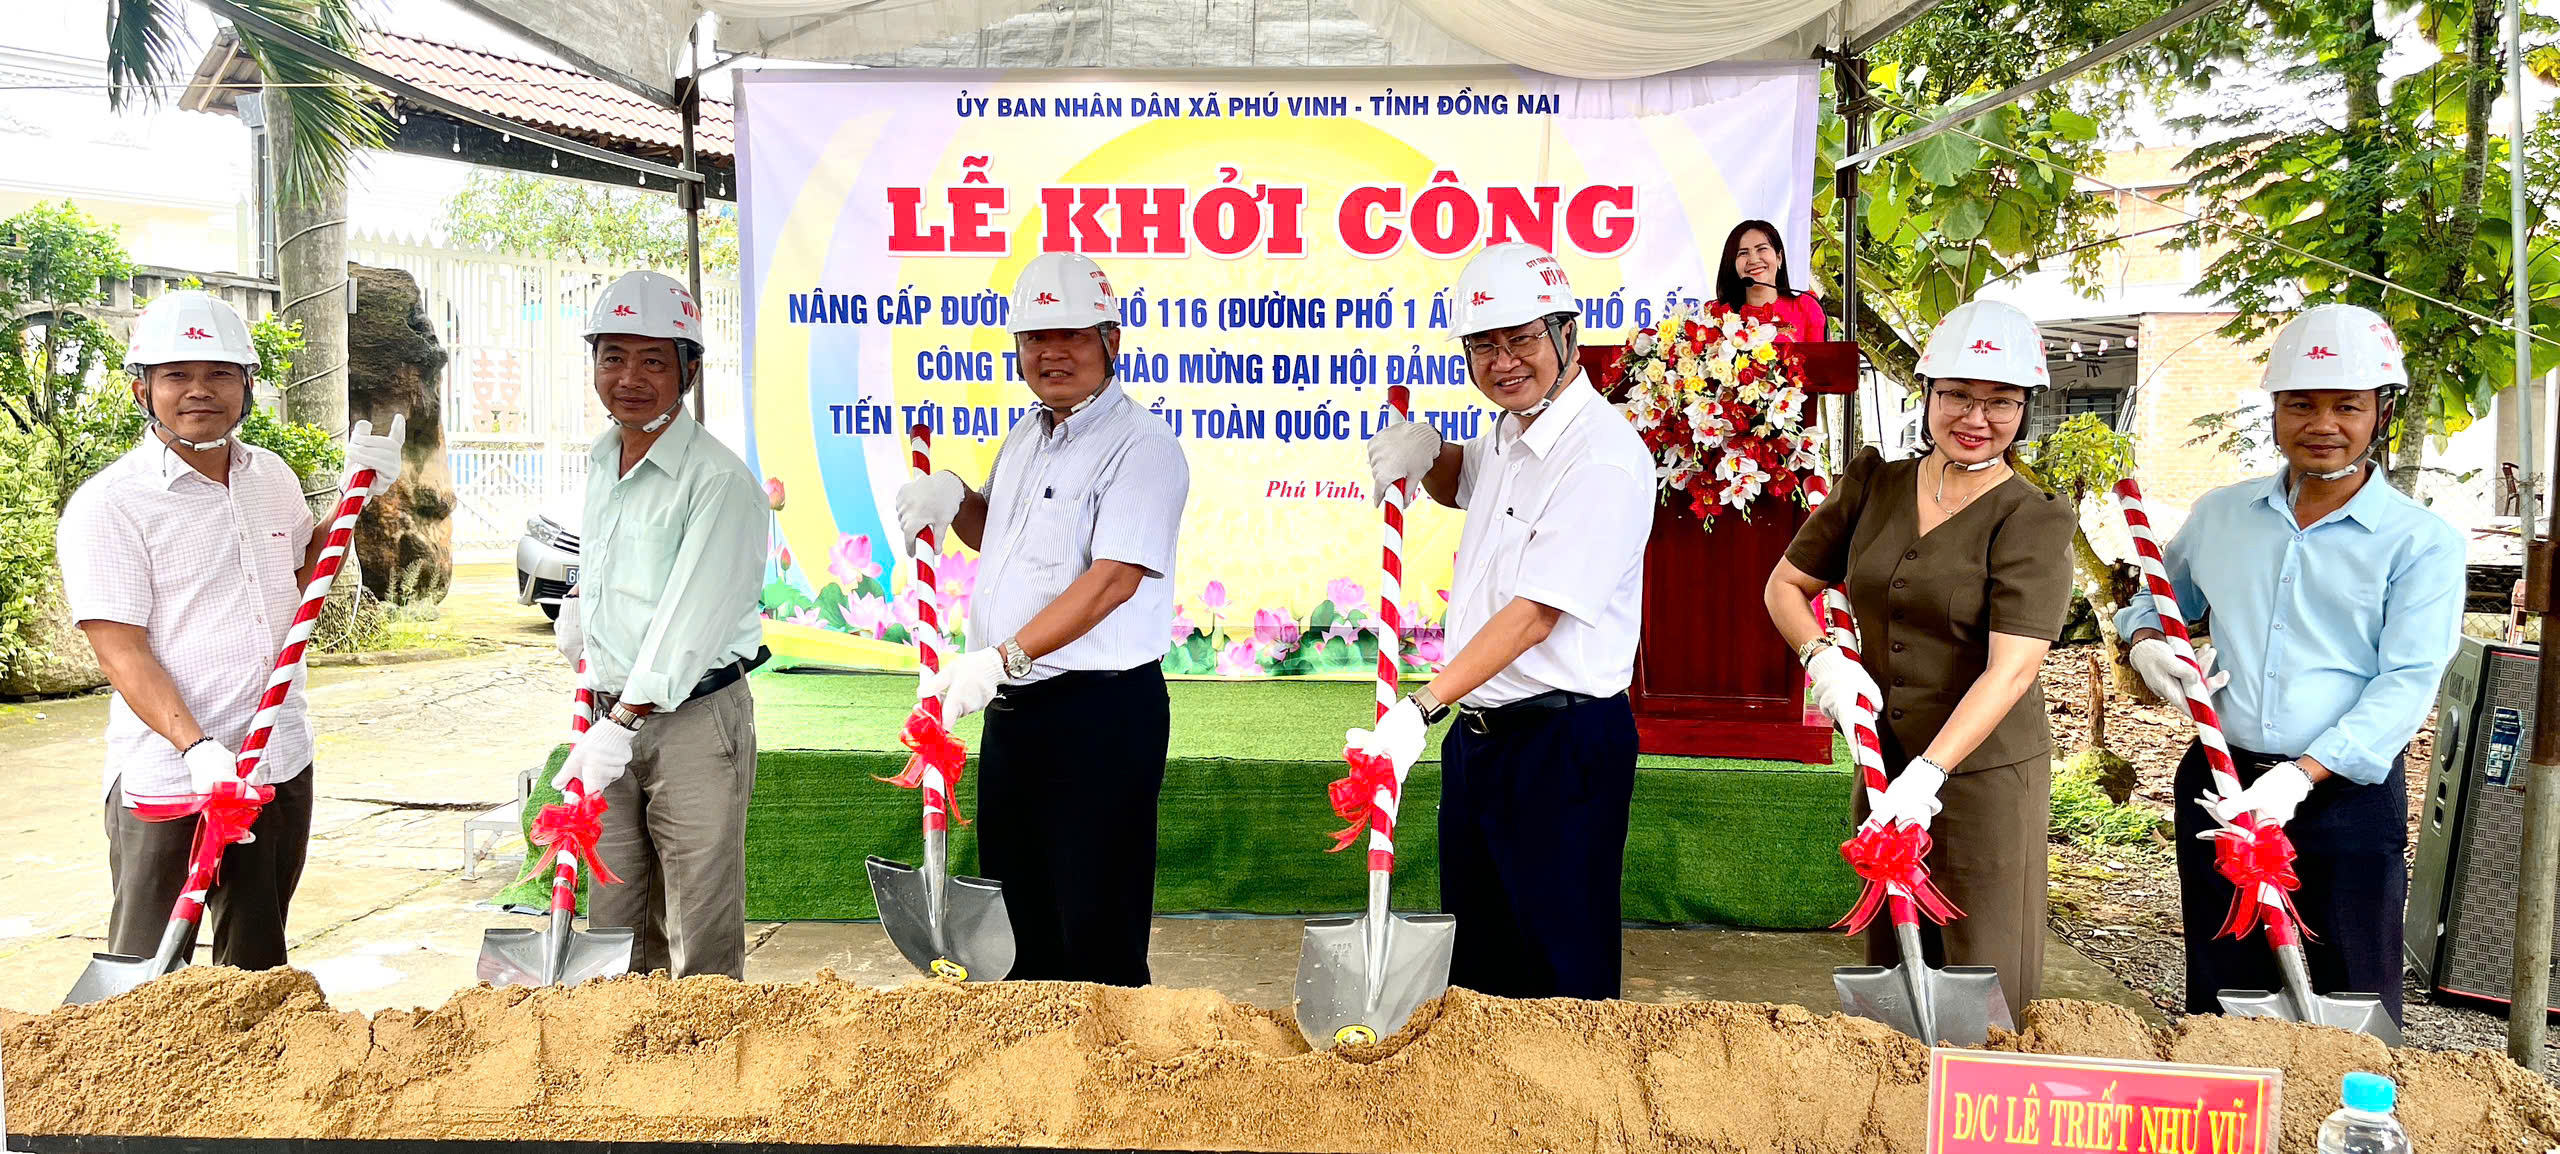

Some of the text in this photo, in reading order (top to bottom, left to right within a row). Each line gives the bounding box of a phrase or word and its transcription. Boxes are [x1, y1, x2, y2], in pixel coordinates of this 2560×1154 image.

[956, 90, 989, 117] ỦY
[997, 97, 1046, 117] BAN
[1054, 92, 1122, 117] NHÂN
[1131, 92, 1180, 117] DÂN
[1188, 91, 1221, 117] XÃ
[1229, 91, 1278, 117] PHÚ
[1287, 96, 1347, 116] VINH
[1370, 88, 1429, 116] TỈNH
[1437, 87, 1508, 116] ĐỒNG
[1517, 94, 1560, 115] NAI
[887, 155, 1635, 255] LỄ KHỞI CÔNG
[789, 288, 868, 324] NÂNG
[877, 285, 931, 325] CẤP
[941, 289, 1010, 326] ĐƯỜN
[1158, 298, 1207, 327] 116
[1219, 291, 1325, 331] (ĐƯỜNG
[1336, 287, 1394, 328] PHỐ
[1404, 298, 1415, 328] 1
[1429, 287, 1452, 328] Ấ
[1635, 298, 1651, 328] 6
[917, 345, 992, 381] CÔNG
[1113, 347, 1168, 383] HÀO
[1179, 348, 1263, 384] MỪNG
[1272, 354, 1319, 391] ĐẠI
[1330, 348, 1376, 391] HỘI
[1386, 345, 1465, 384] ĐẢNG
[829, 396, 892, 434] TIẾN
[902, 400, 943, 435] TỚI
[953, 407, 998, 442] ĐẠI
[1192, 403, 1265, 439] TOÀN
[1275, 400, 1350, 442] QUỐC
[1265, 480, 1365, 501] Phú Vinh,
[1952, 1079, 2248, 1154] Đ/C LÊ TRIẾT NHƯ VŨ
